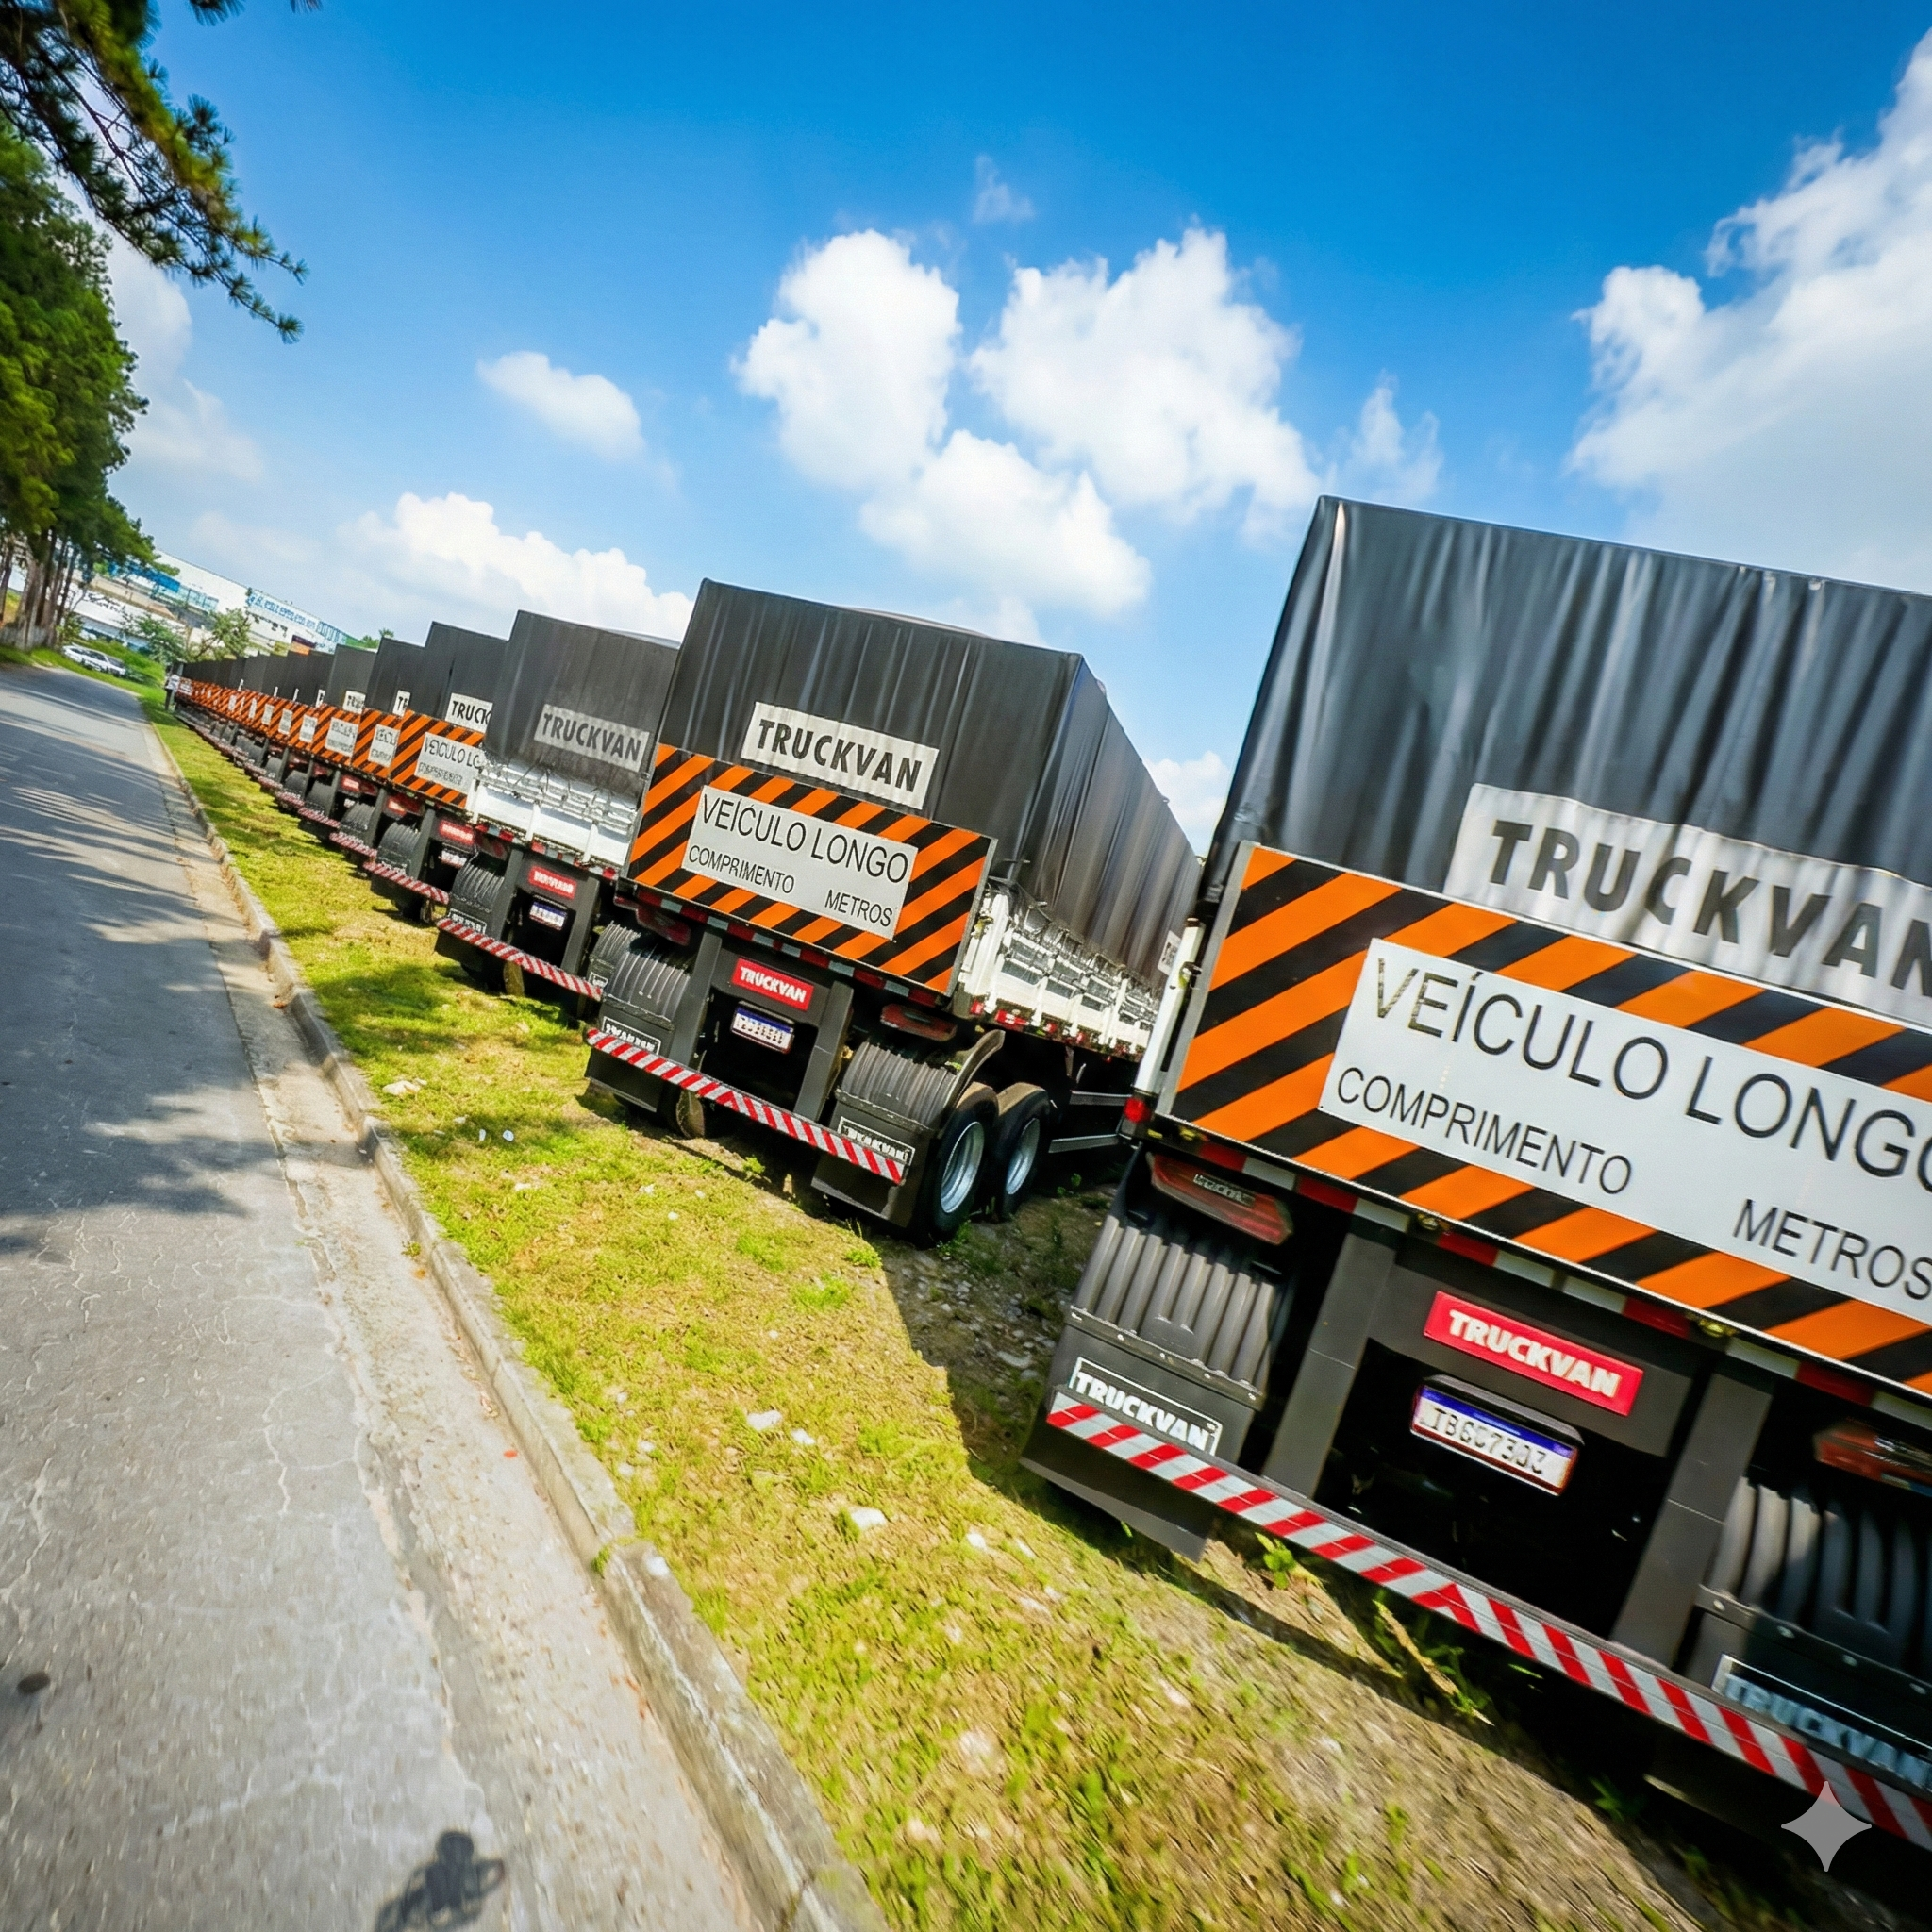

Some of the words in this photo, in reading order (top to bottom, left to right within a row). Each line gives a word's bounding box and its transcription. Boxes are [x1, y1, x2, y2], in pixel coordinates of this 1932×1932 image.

[543, 713, 641, 763] TRUCKVAN
[758, 719, 924, 793] TRUCKVAN
[703, 790, 807, 851] VEÍCULO
[810, 828, 909, 883] LONGO
[689, 845, 794, 895] COMPRIMENTO
[824, 890, 894, 927] METROS
[740, 967, 807, 1003] TRUCKVAN
[1376, 958, 1669, 1100] VEÍCULO
[1336, 1066, 1633, 1194] COMPRIMENTO
[1733, 1198, 1932, 1301] METROS
[1447, 1309, 1623, 1398] TRUCKVAN
[1075, 1372, 1209, 1451] TRUCKVAN
